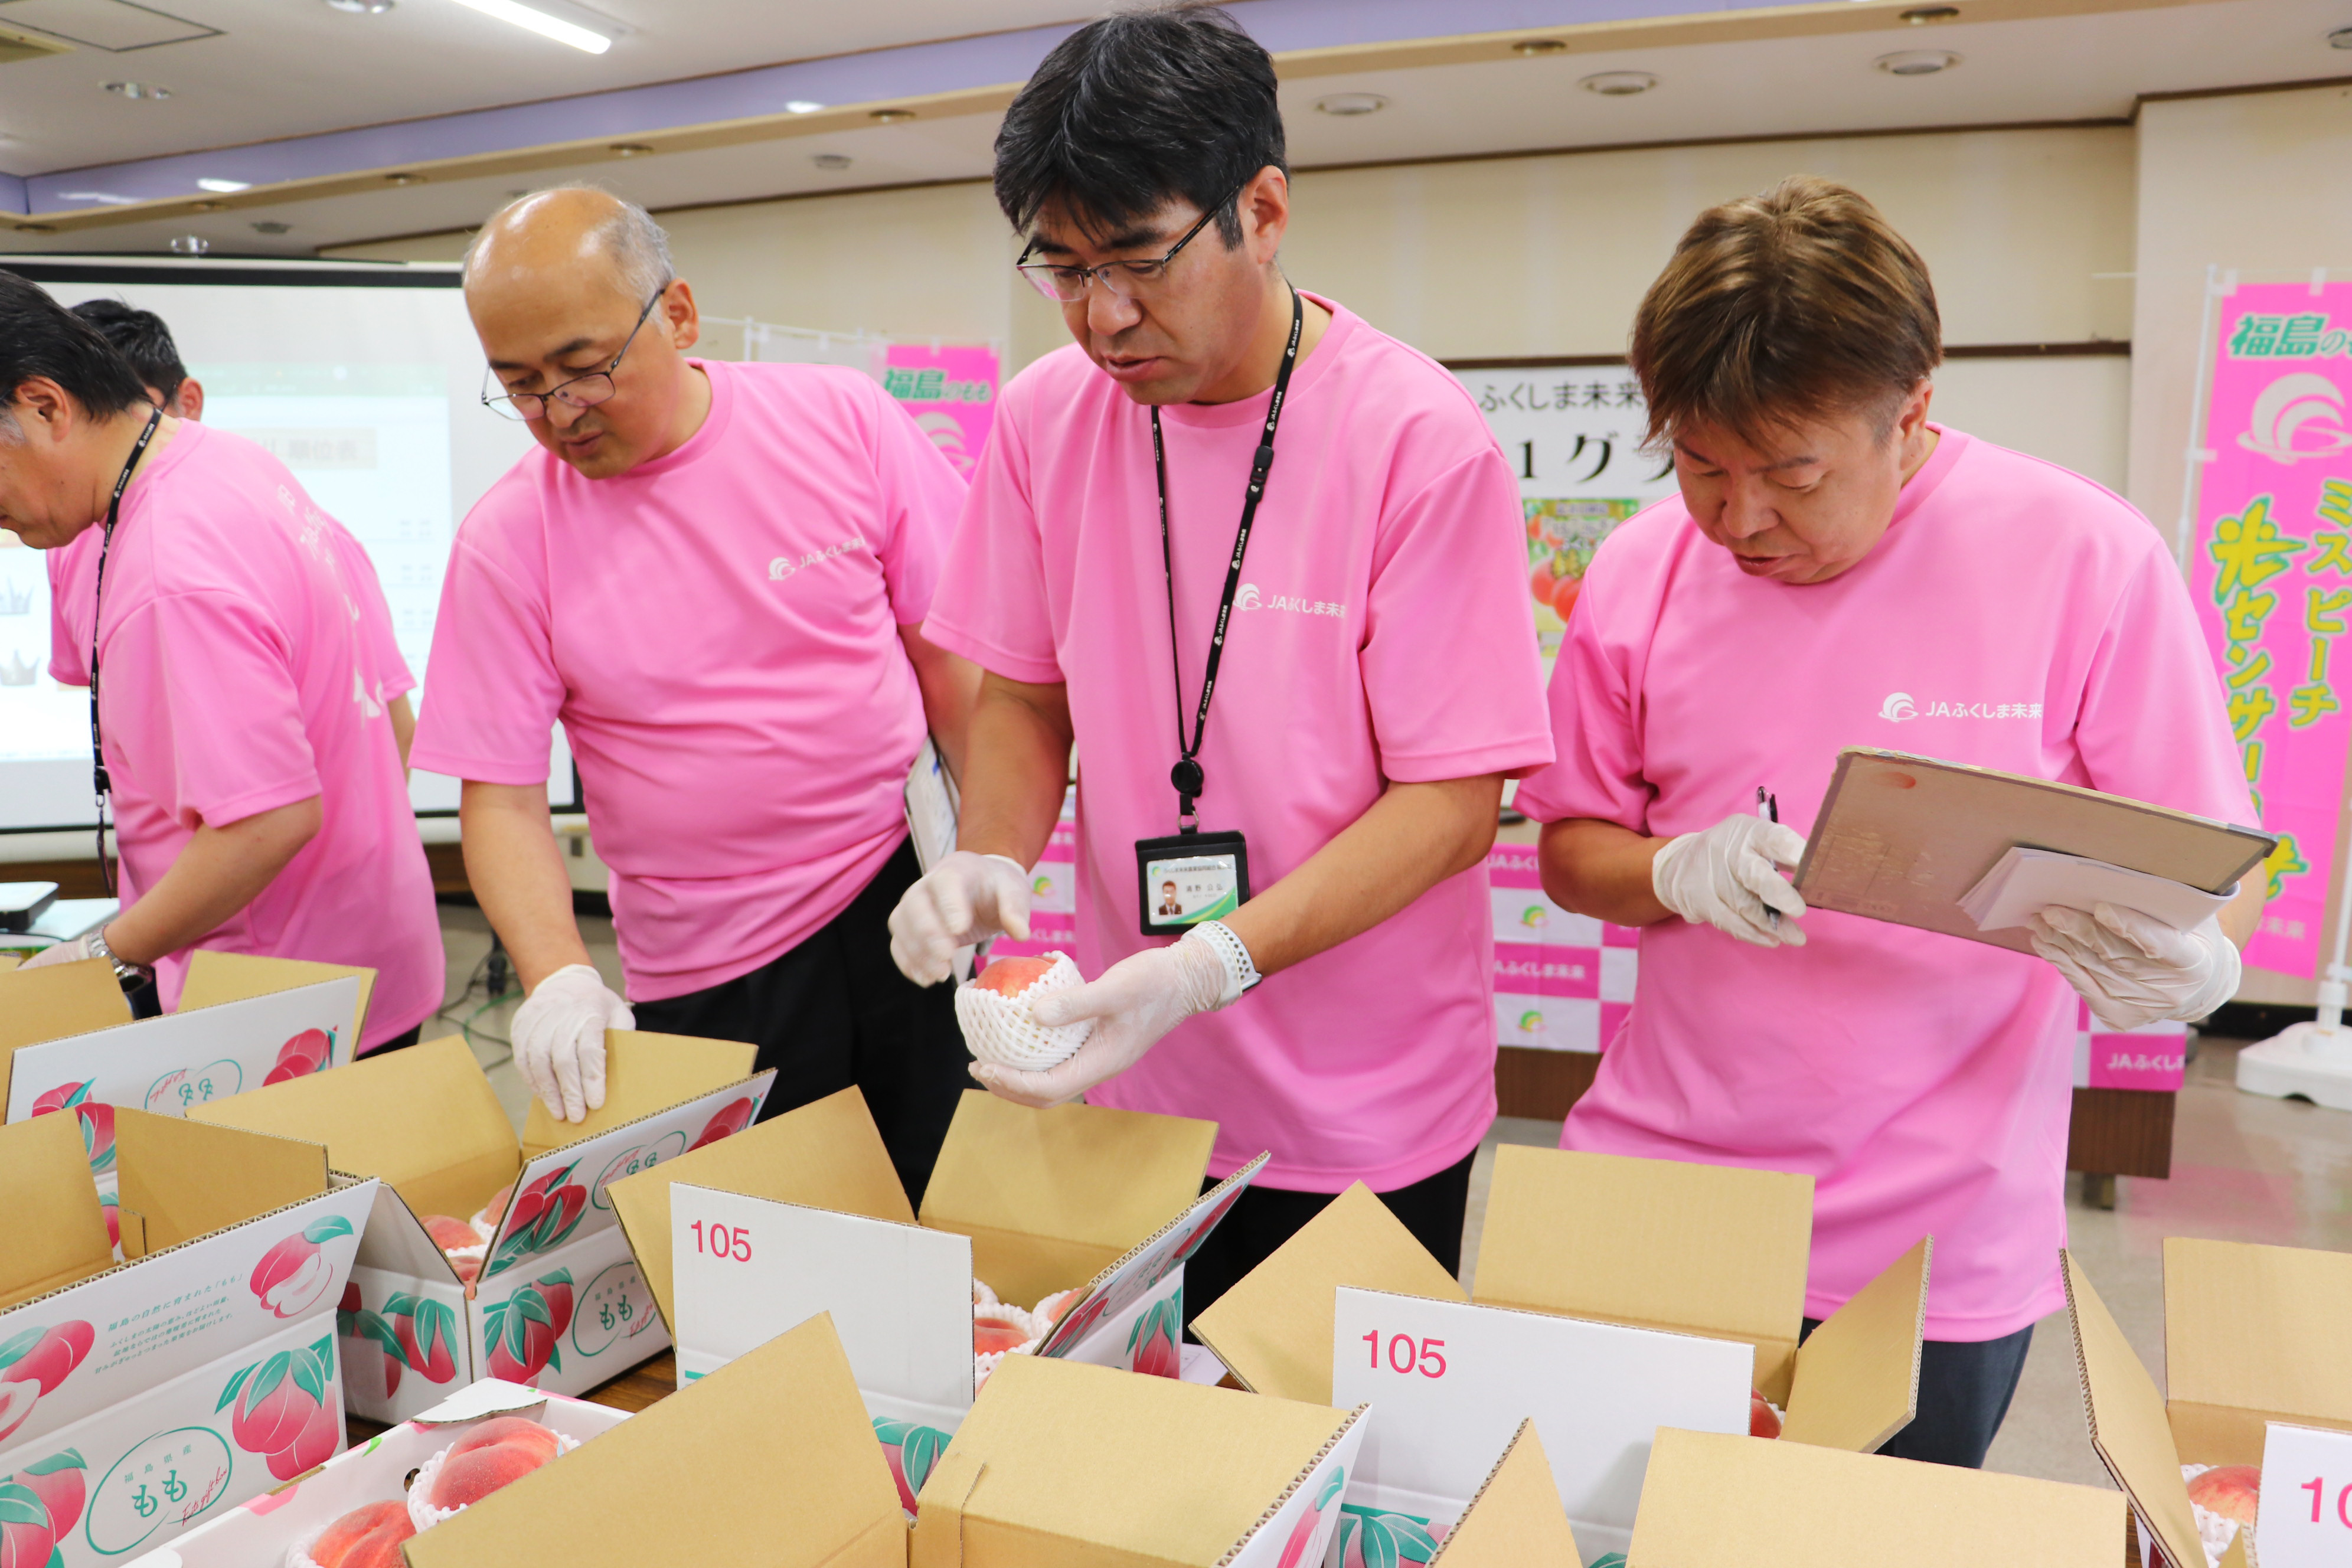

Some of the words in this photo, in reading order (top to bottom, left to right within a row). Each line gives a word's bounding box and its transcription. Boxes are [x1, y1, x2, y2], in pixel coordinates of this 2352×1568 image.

[1479, 380, 1643, 412] ふくしま未来
[1925, 701, 2043, 718] JAふくしま未来
[691, 1220, 752, 1262] 105
[599, 1293, 633, 1331] もも
[1362, 1330, 1447, 1378] 105
[124, 1444, 192, 1484] 福島県産
[131, 1469, 188, 1518] もも
